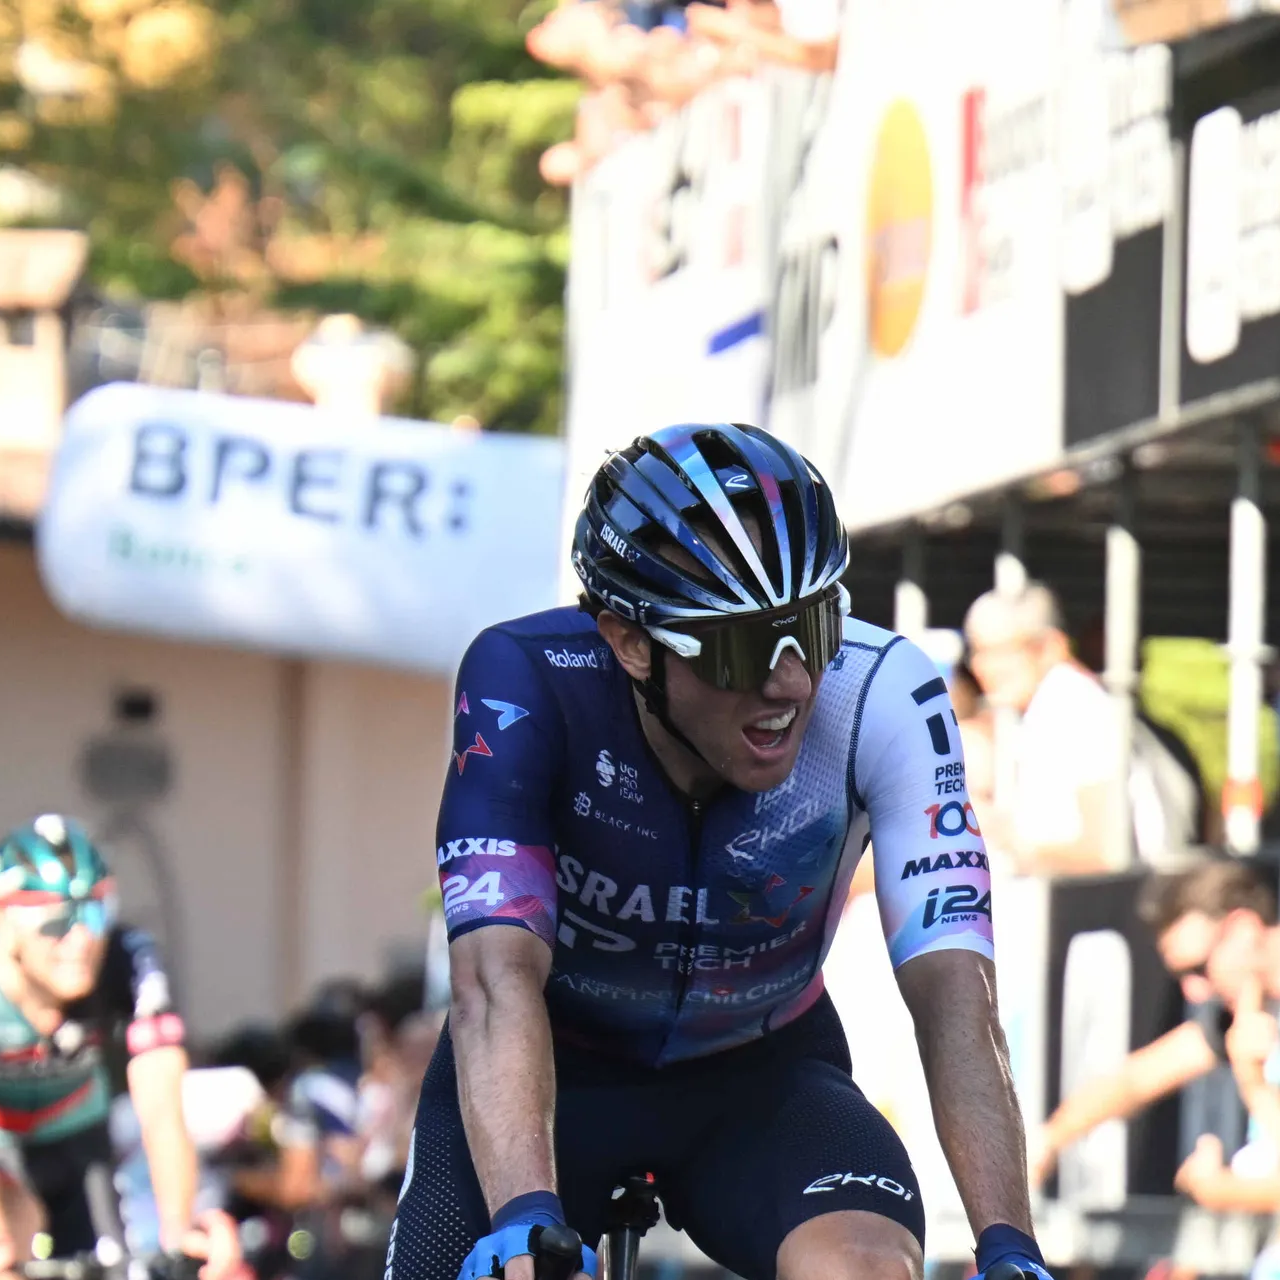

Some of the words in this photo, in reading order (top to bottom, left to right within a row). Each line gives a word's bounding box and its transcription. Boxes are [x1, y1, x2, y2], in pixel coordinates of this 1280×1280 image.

[600, 523, 628, 559] ISRAEL
[544, 648, 598, 668] Roland
[620, 760, 638, 779] UCI
[935, 779, 967, 796] TECH
[595, 809, 631, 832] BLACK
[637, 826, 659, 840] INC
[437, 837, 517, 866] AXXIS
[901, 851, 990, 881] MAXX
[442, 871, 505, 912] 24
[554, 843, 720, 925] SRAEL
[446, 902, 469, 918] EWS
[940, 914, 978, 925] NEWS
